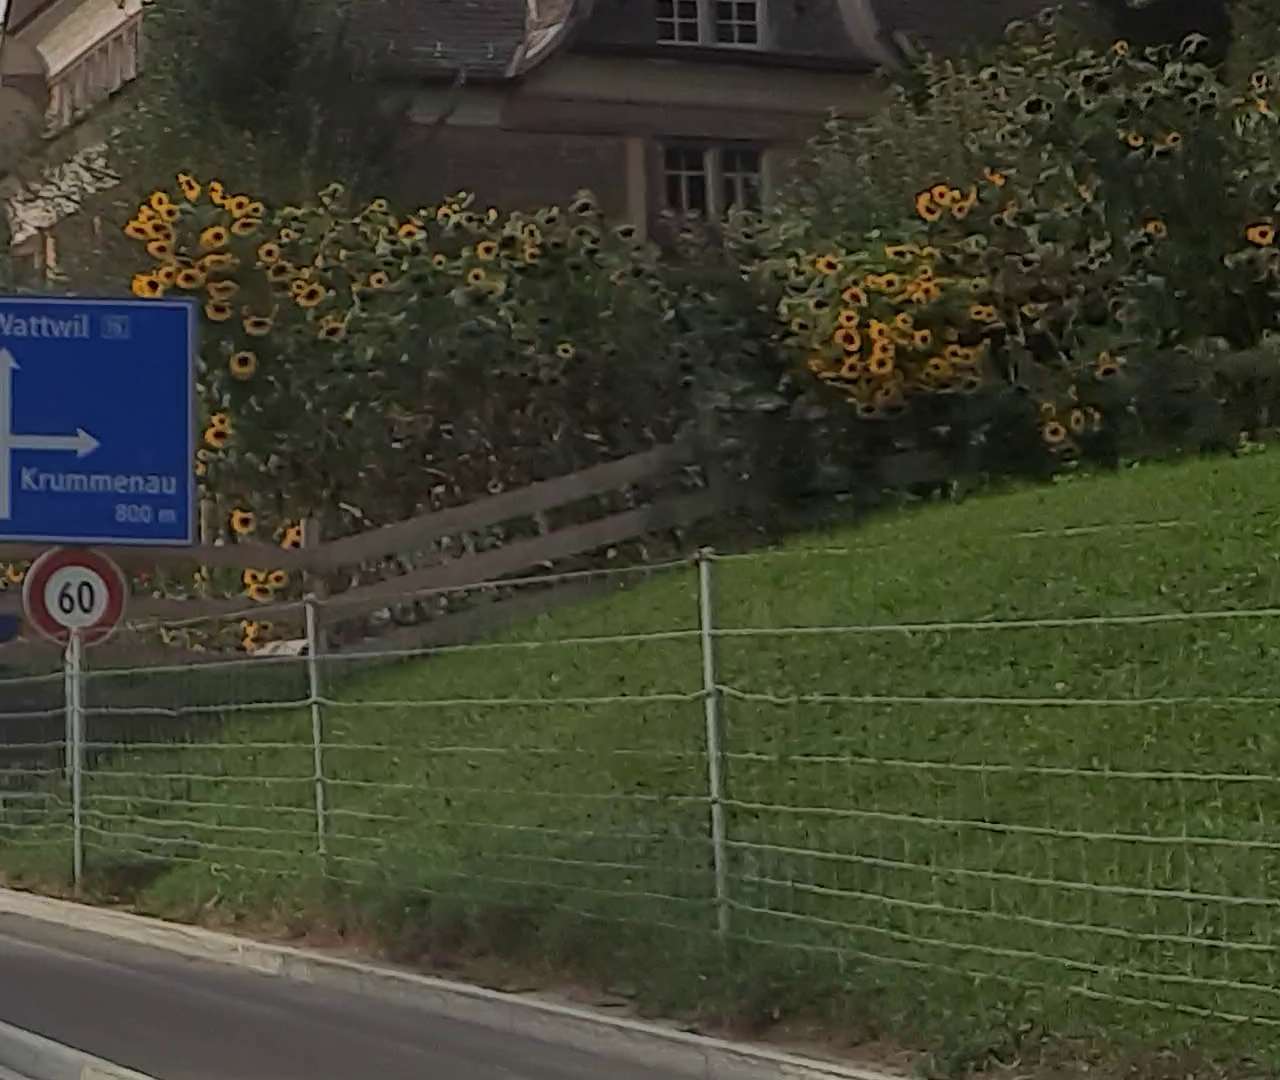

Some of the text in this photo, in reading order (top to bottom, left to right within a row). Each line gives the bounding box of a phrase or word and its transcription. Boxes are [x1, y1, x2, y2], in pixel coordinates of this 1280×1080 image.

[20, 467, 176, 494] Krummenau
[115, 503, 176, 523] 800 m
[58, 581, 95, 614] 60
